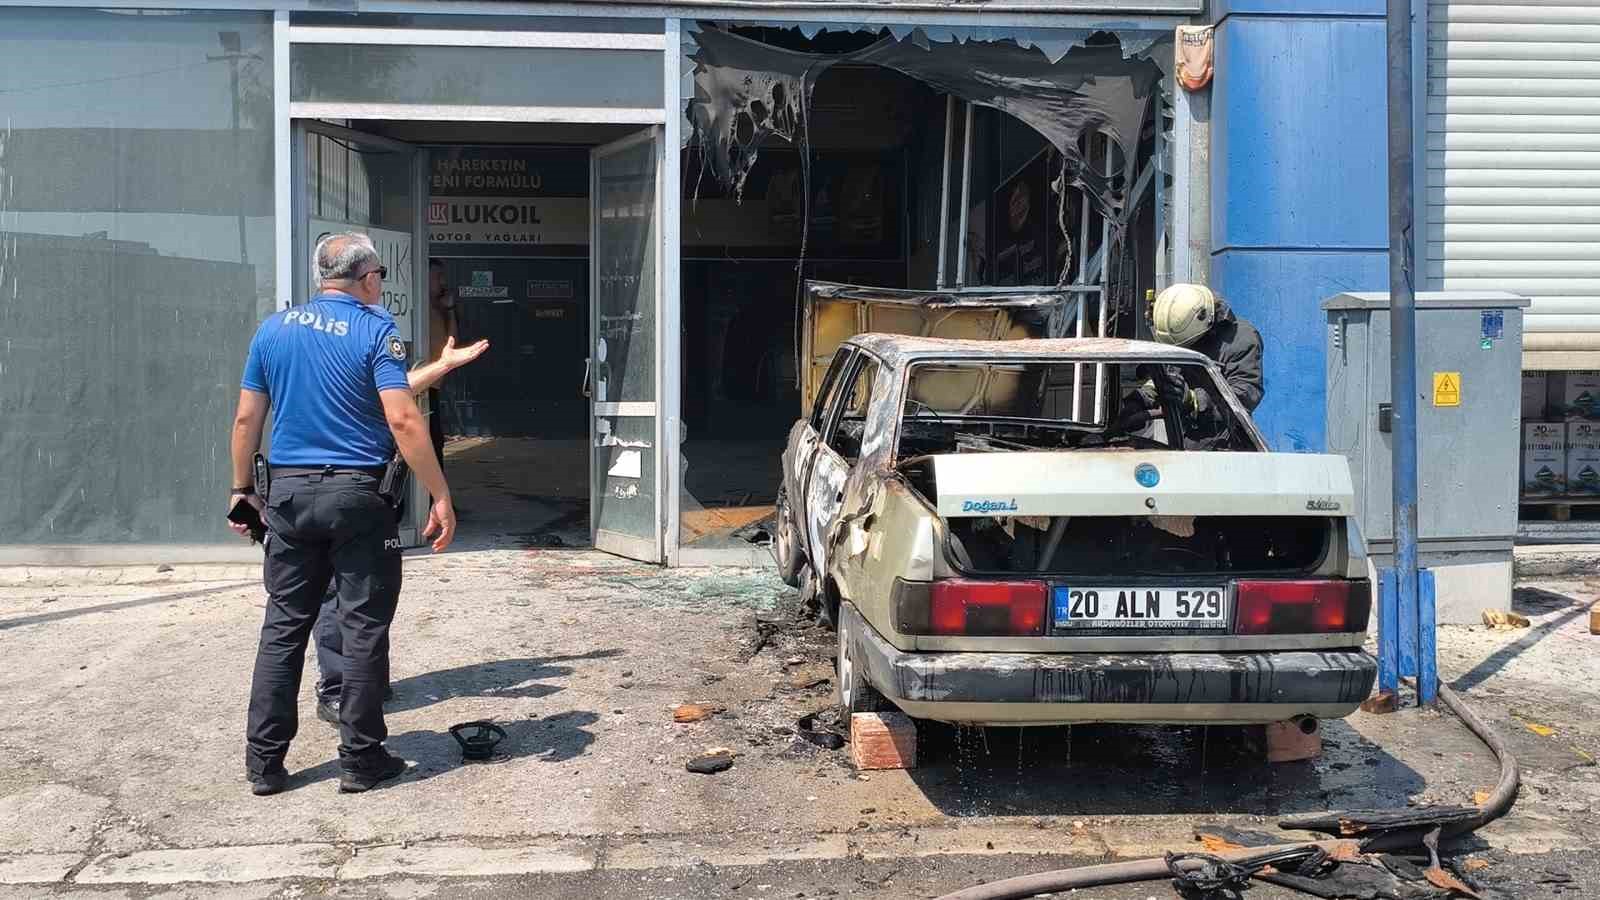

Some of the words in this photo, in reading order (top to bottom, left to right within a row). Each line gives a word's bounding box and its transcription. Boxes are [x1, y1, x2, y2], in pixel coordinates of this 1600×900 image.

[452, 204, 542, 224] LUKOIL
[1069, 590, 1099, 618] 20
[1115, 590, 1160, 618] ALN
[1175, 590, 1221, 618] 529
